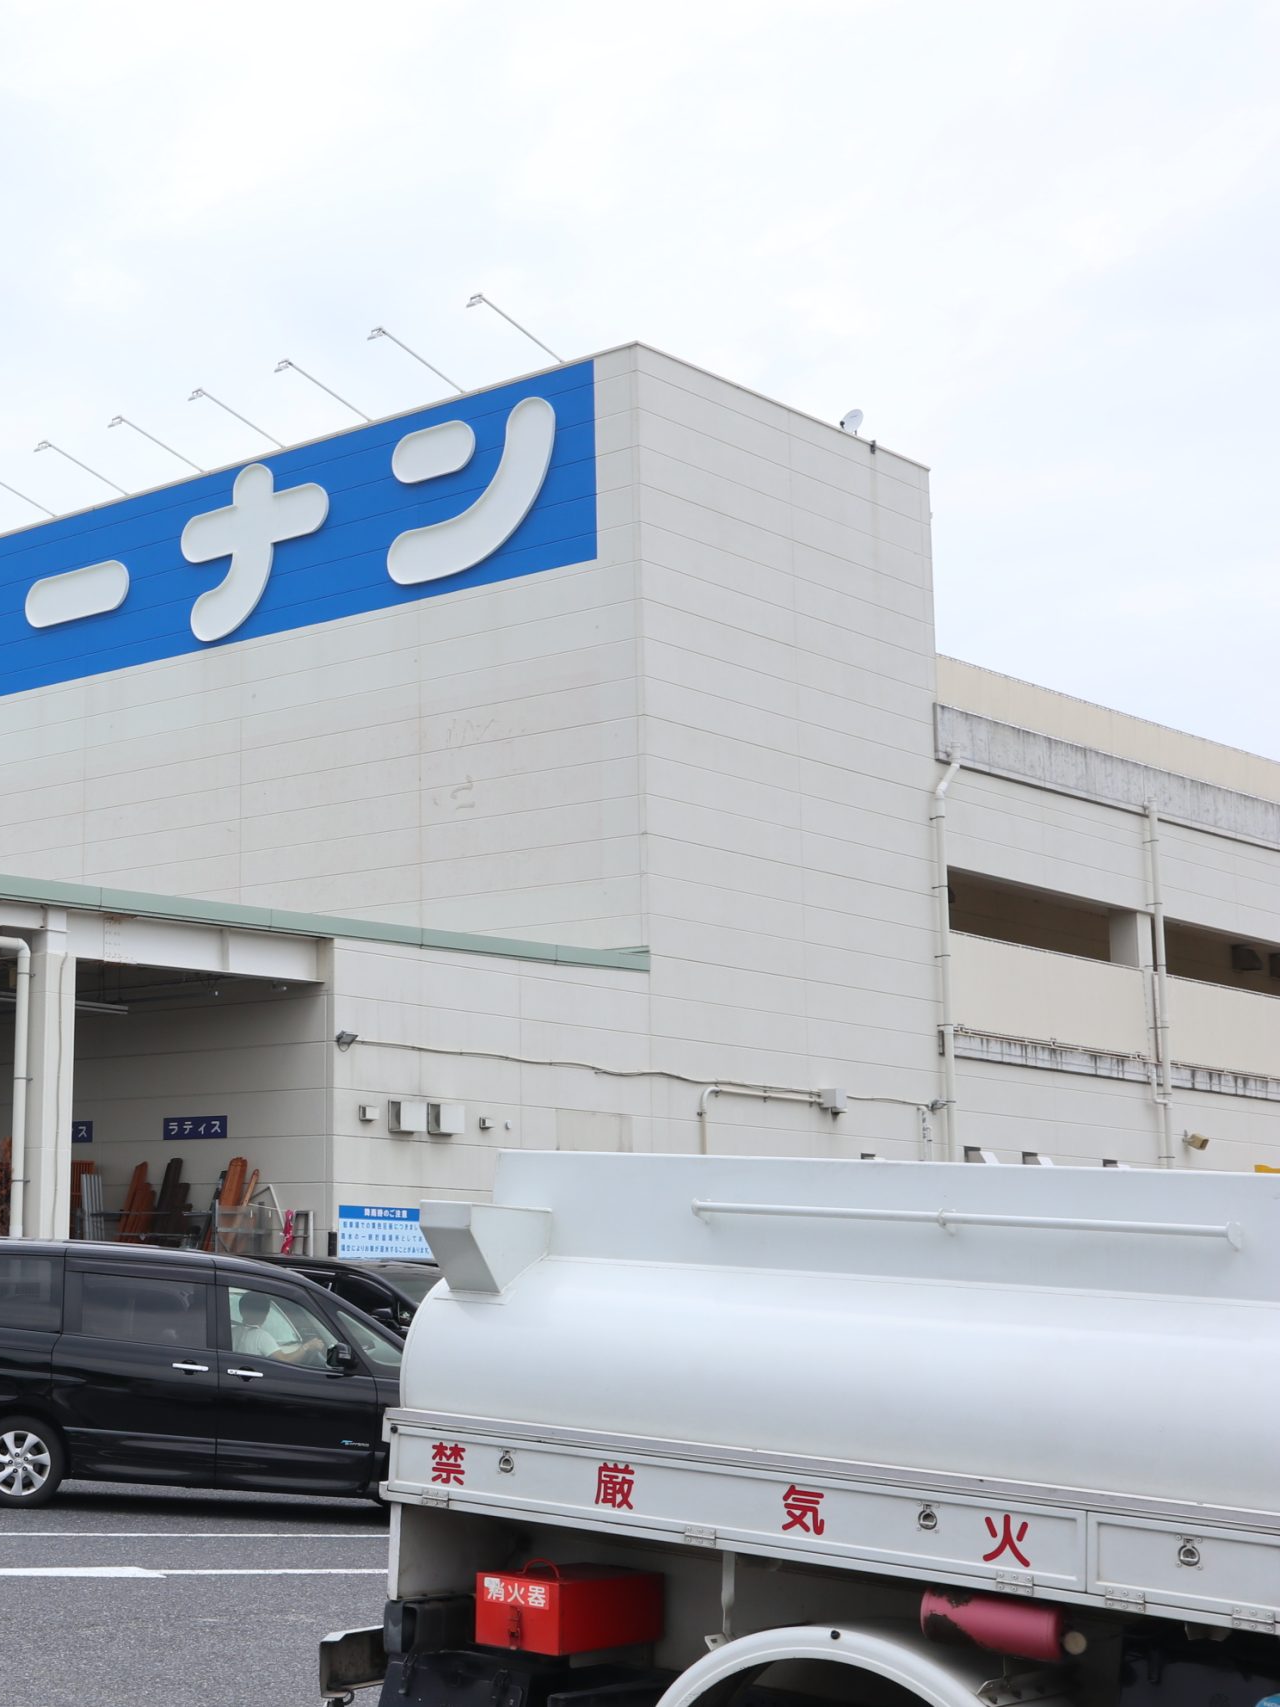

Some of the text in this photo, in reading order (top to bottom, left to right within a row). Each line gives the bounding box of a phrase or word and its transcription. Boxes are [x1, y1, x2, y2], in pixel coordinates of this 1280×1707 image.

[168, 1120, 222, 1136] ラティス
[486, 1580, 546, 1608] 消火器
